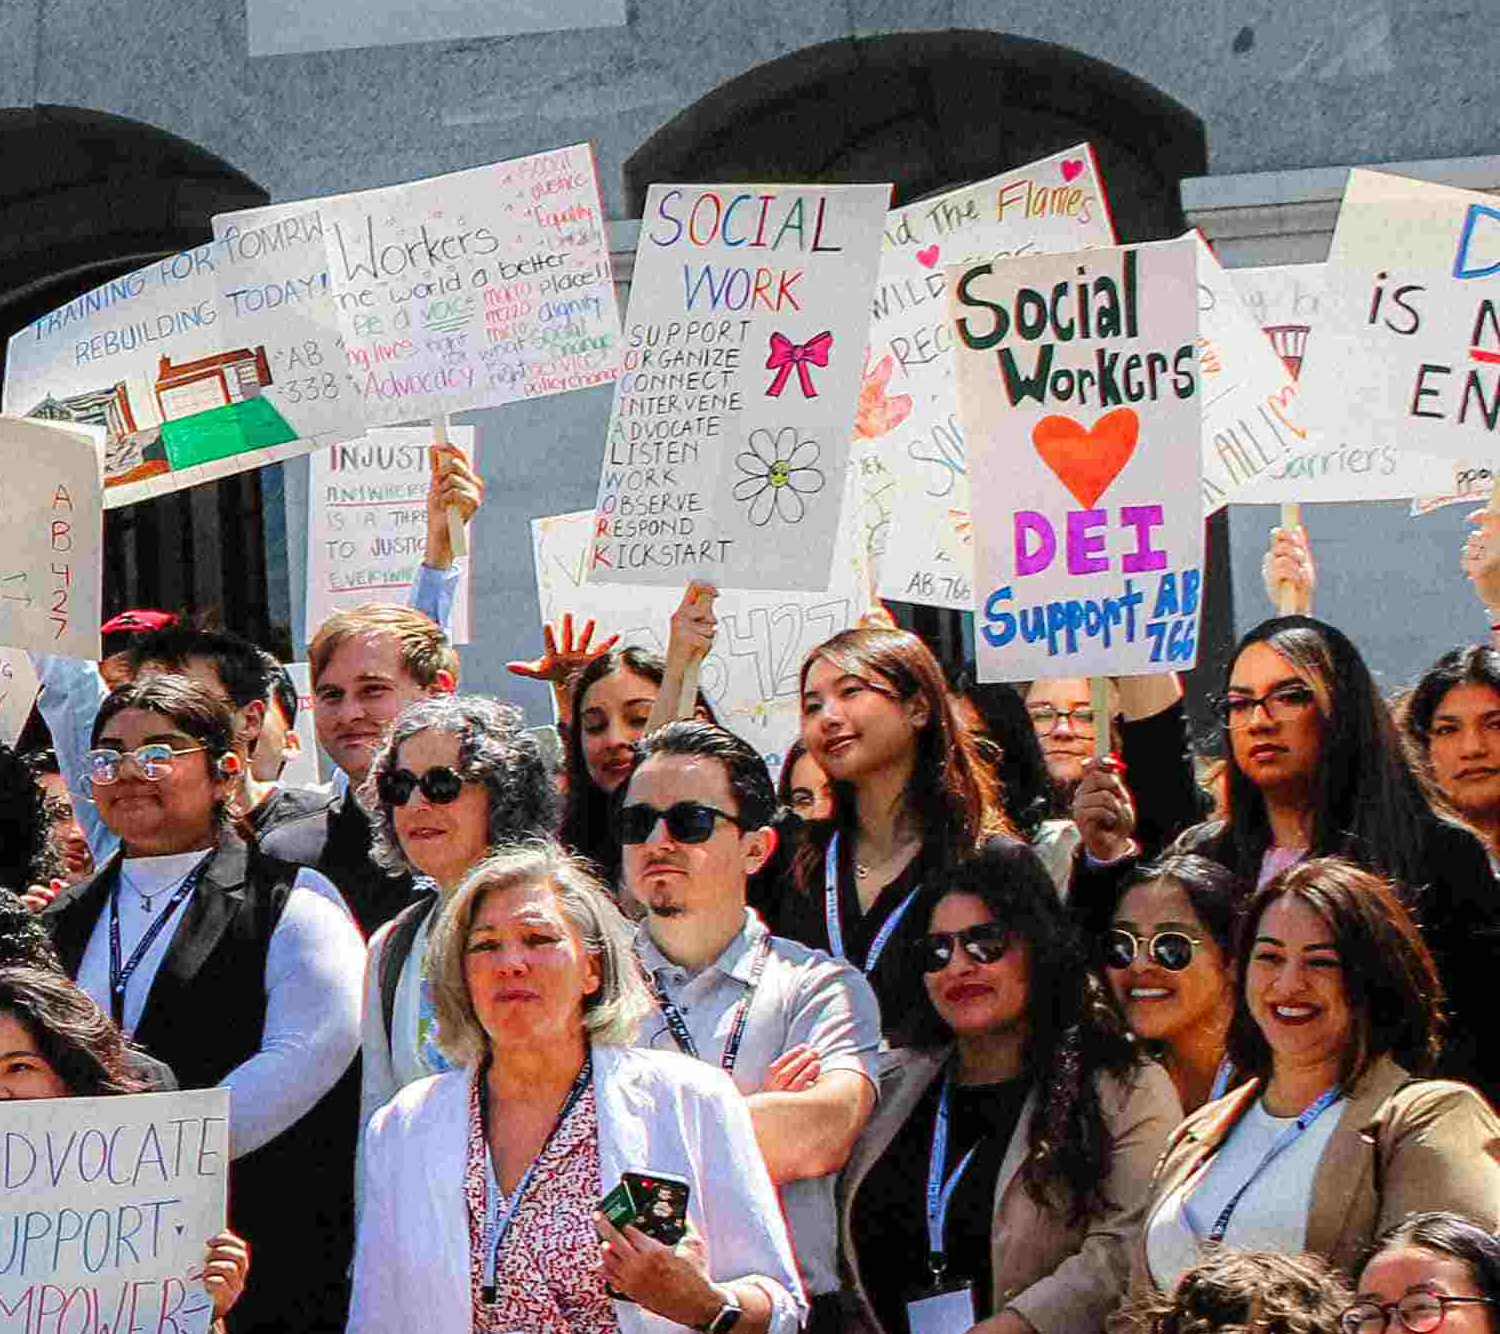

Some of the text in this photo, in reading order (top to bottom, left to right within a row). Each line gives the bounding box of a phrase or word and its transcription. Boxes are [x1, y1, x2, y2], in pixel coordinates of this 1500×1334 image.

[650, 190, 842, 252] SOCIAL
[928, 179, 1094, 235] The Flames
[335, 216, 499, 281] Workers
[500, 253, 571, 280] better
[34, 250, 214, 339] TRAINING FOR
[684, 266, 802, 312] WORK
[956, 250, 1139, 351] Social
[76, 273, 329, 364] REBUILDING TODAY!
[629, 320, 752, 347] SUPPORT
[624, 348, 741, 371] ORGANIZE
[999, 343, 1197, 409] Workers
[622, 370, 732, 393] CONNECT
[620, 393, 742, 416] INTERVENE
[615, 416, 721, 441] ADVOCATE
[611, 442, 699, 466] LISTEN
[605, 469, 678, 492] WORK
[603, 493, 702, 516] OBSERVE
[596, 517, 694, 539] RESPOND
[1013, 504, 1168, 578] DEI
[50, 484, 76, 640] AB427
[325, 540, 357, 560] TO
[593, 540, 733, 571] KICKSTART
[982, 568, 1200, 657] Support AB
[1146, 618, 1196, 663] 766
